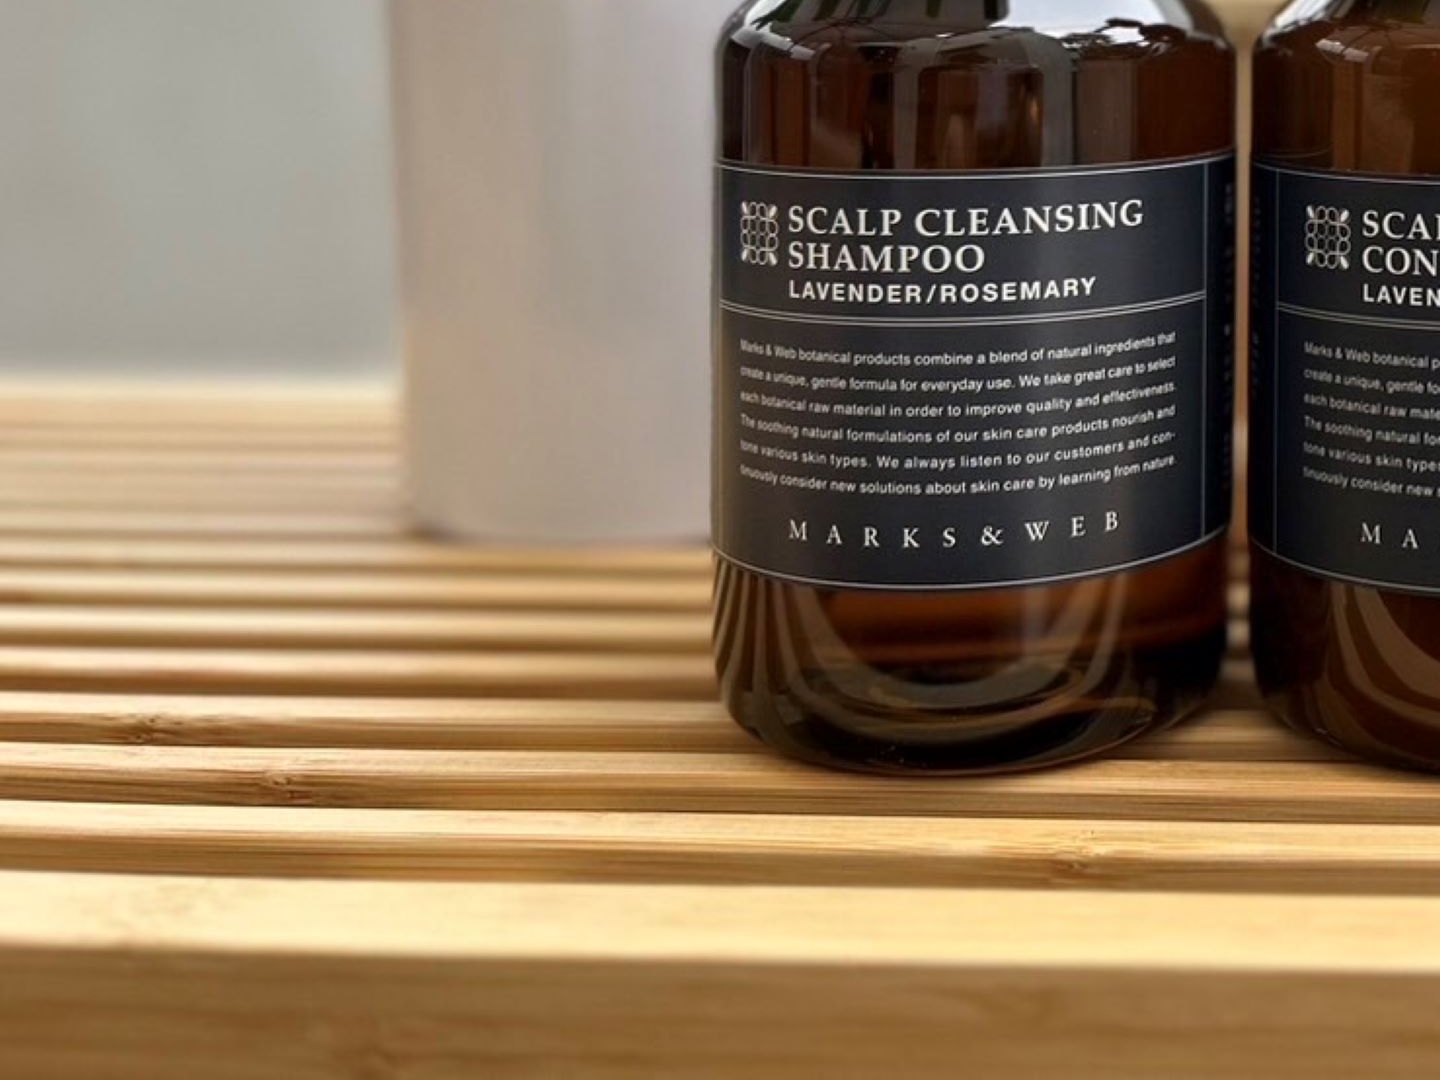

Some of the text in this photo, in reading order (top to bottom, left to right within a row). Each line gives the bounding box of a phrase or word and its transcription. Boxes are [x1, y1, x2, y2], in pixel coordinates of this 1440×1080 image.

[788, 199, 1143, 237] SCALP CLEANSING
[788, 242, 985, 273] SHAMPOO
[788, 276, 1096, 303] LAVENDER/ROSEMARY
[799, 344, 1092, 366] botanical products combine a blend of natural
[1345, 348, 1370, 363] Web
[1372, 352, 1429, 368] botanical
[811, 366, 1133, 393] gentle formula for everyday use. We take great care
[1386, 381, 1425, 393] gentle
[833, 393, 1099, 417] material in order to improve quality and
[1329, 397, 1381, 415] botanical
[1384, 406, 1407, 417] raw
[801, 419, 1109, 443] natural formulations of our skin care products
[1376, 430, 1421, 444] natural
[877, 456, 899, 468] We
[904, 457, 955, 471] always
[961, 456, 1002, 467] listen
[1007, 454, 1021, 465] to
[1026, 452, 1050, 464] our
[1054, 442, 1124, 461] customers
[1376, 454, 1403, 468] skin
[830, 469, 1111, 495] new solutions about skin care by learning
[1351, 477, 1403, 493] consider
[1406, 485, 1433, 496] new
